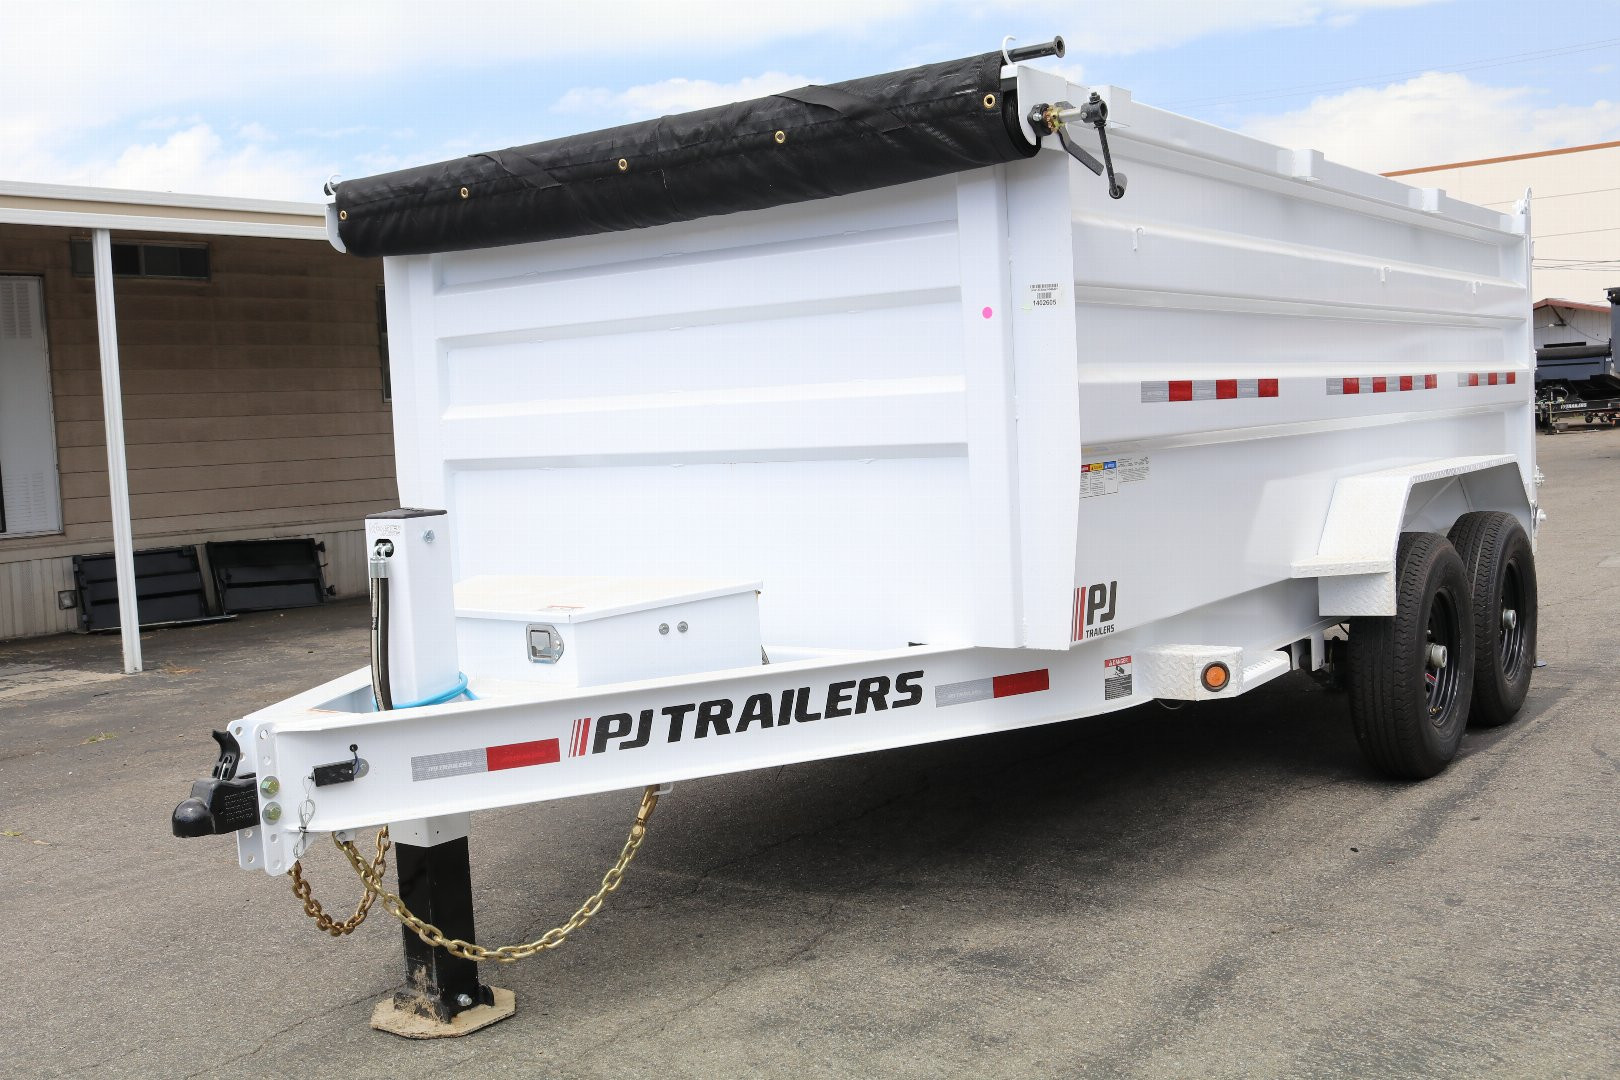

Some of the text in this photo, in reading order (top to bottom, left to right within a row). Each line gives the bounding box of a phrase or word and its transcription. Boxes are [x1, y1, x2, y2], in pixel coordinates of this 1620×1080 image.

[1087, 581, 1117, 626] PJ
[1086, 624, 1115, 639] TRAILERS
[592, 670, 924, 754] PJ TRAILERS
